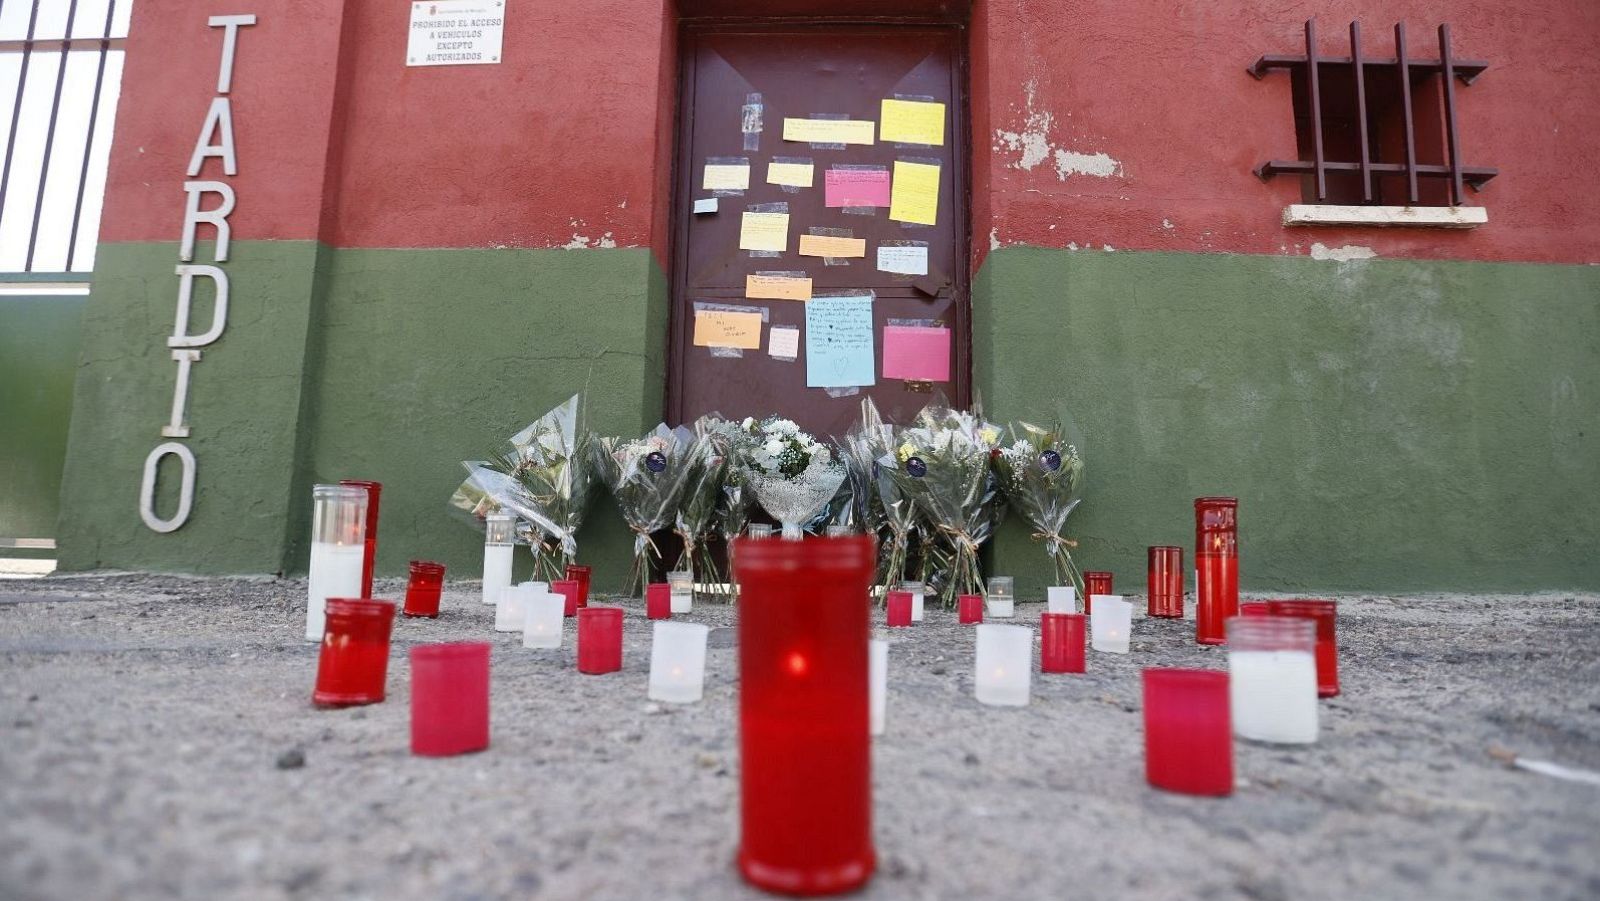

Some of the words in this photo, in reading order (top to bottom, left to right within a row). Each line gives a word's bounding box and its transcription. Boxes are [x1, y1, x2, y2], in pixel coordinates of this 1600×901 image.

[413, 20, 456, 29] PROHIBIDO
[471, 18, 502, 27] ACCESO
[437, 30, 482, 39] VEHICULOS
[437, 41, 473, 50] EXCEPTO
[426, 52, 482, 62] AUTORIZADOS
[140, 14, 257, 534] TARDIO
